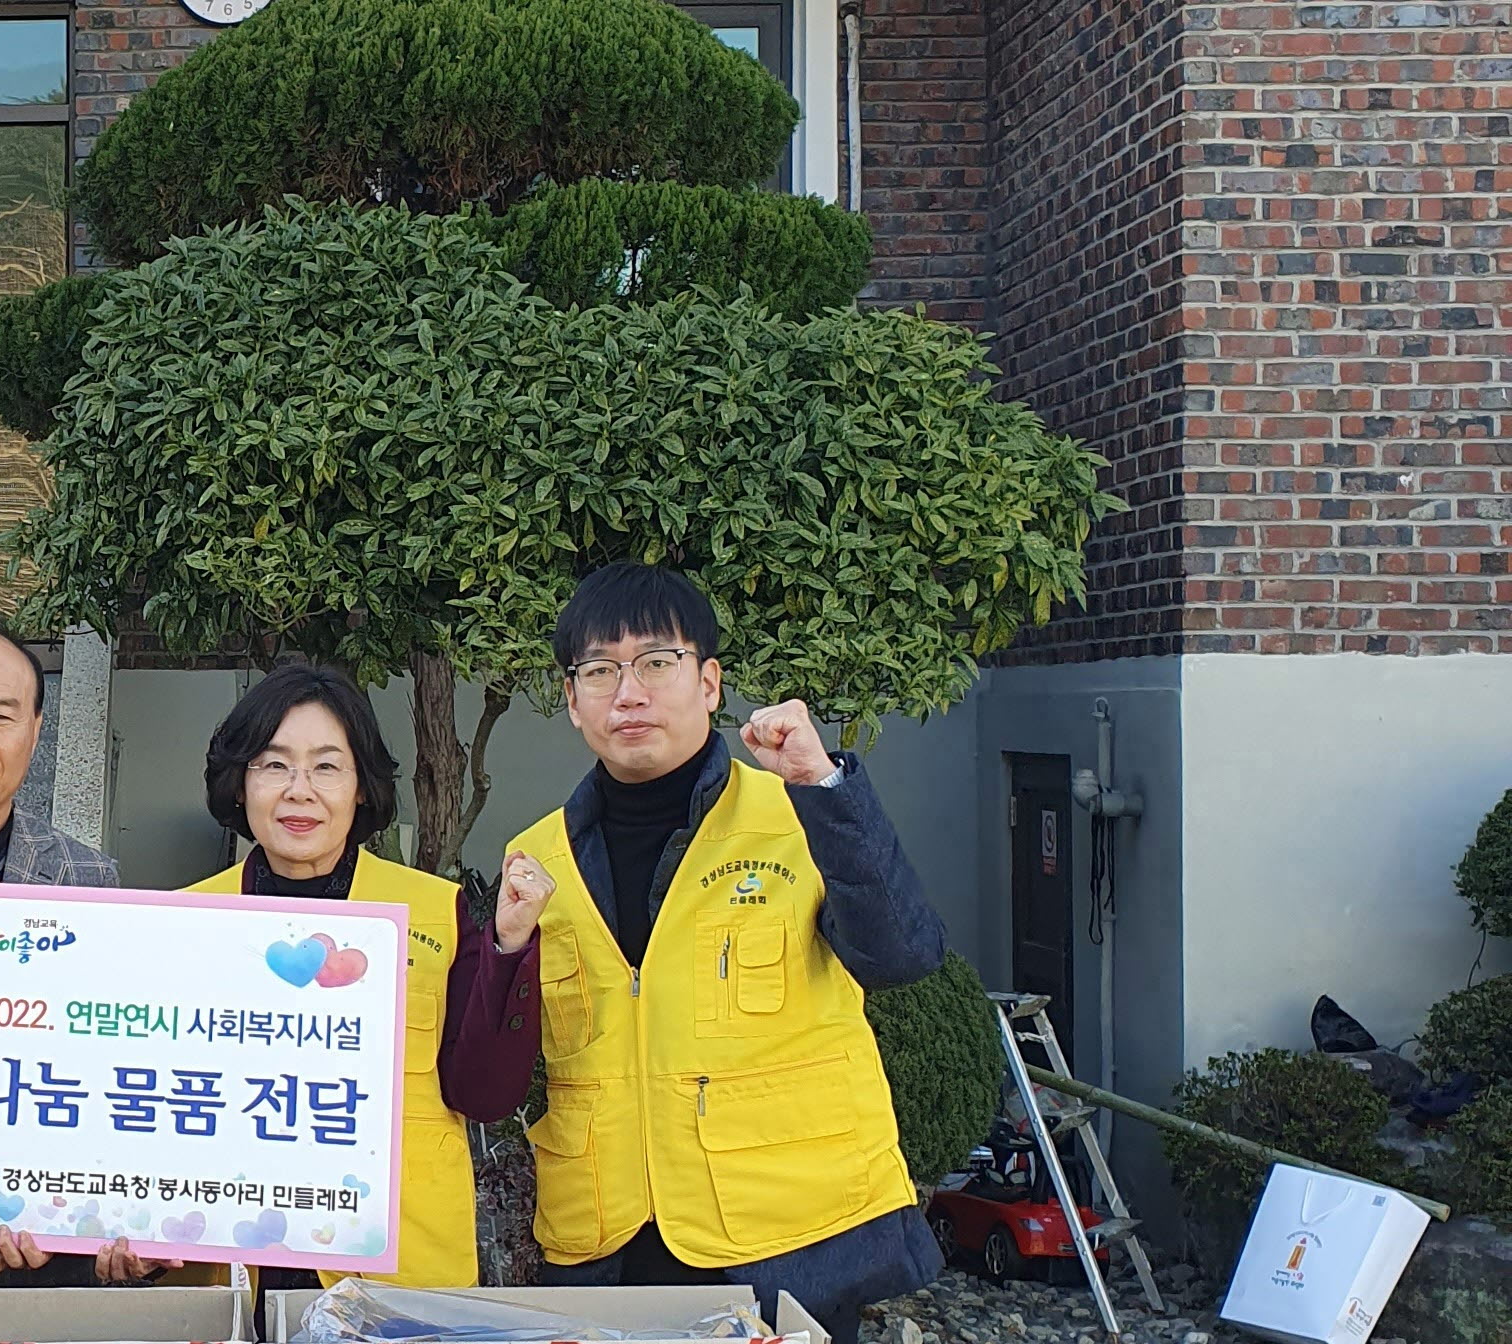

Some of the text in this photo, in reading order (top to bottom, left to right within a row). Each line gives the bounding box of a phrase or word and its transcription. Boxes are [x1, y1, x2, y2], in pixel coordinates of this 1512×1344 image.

[206, 0, 213, 11] 7
[224, 4, 232, 15] 6
[24, 919, 57, 929] 경남교육
[66, 1000, 179, 1040] 연말연시
[187, 1007, 361, 1052] 사회복지시설
[104, 1066, 226, 1136] 물품
[241, 1074, 369, 1146] 전달
[2, 1167, 358, 1213] 경상남도교육청 봉사동아리 민들레회
